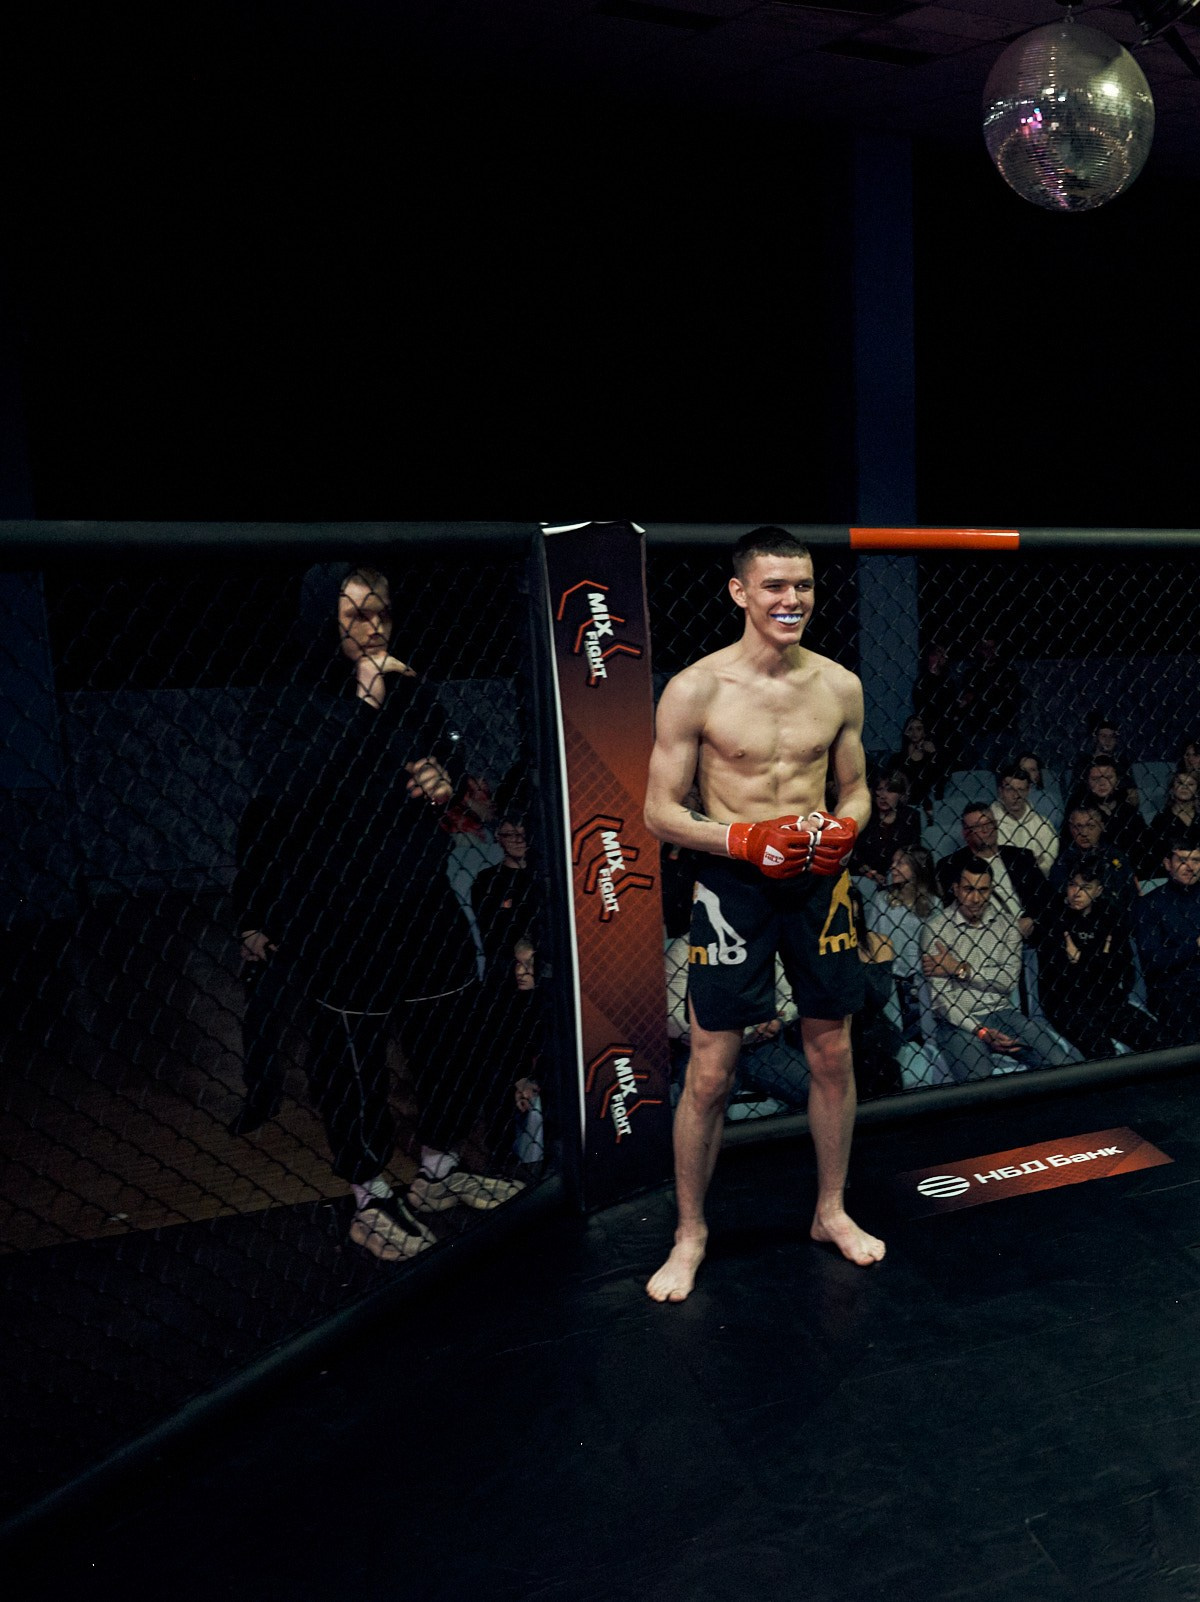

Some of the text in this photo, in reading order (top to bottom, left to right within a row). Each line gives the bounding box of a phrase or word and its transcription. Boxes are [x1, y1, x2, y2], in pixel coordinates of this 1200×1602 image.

[587, 592, 614, 638] MIX
[585, 630, 608, 679] FIGHT
[601, 830, 626, 874] MIX
[599, 867, 620, 912] FIGHT
[614, 1057, 638, 1098] MIX
[611, 1092, 632, 1136] FIGHT
[973, 1145, 1125, 1184] НБД Банк
